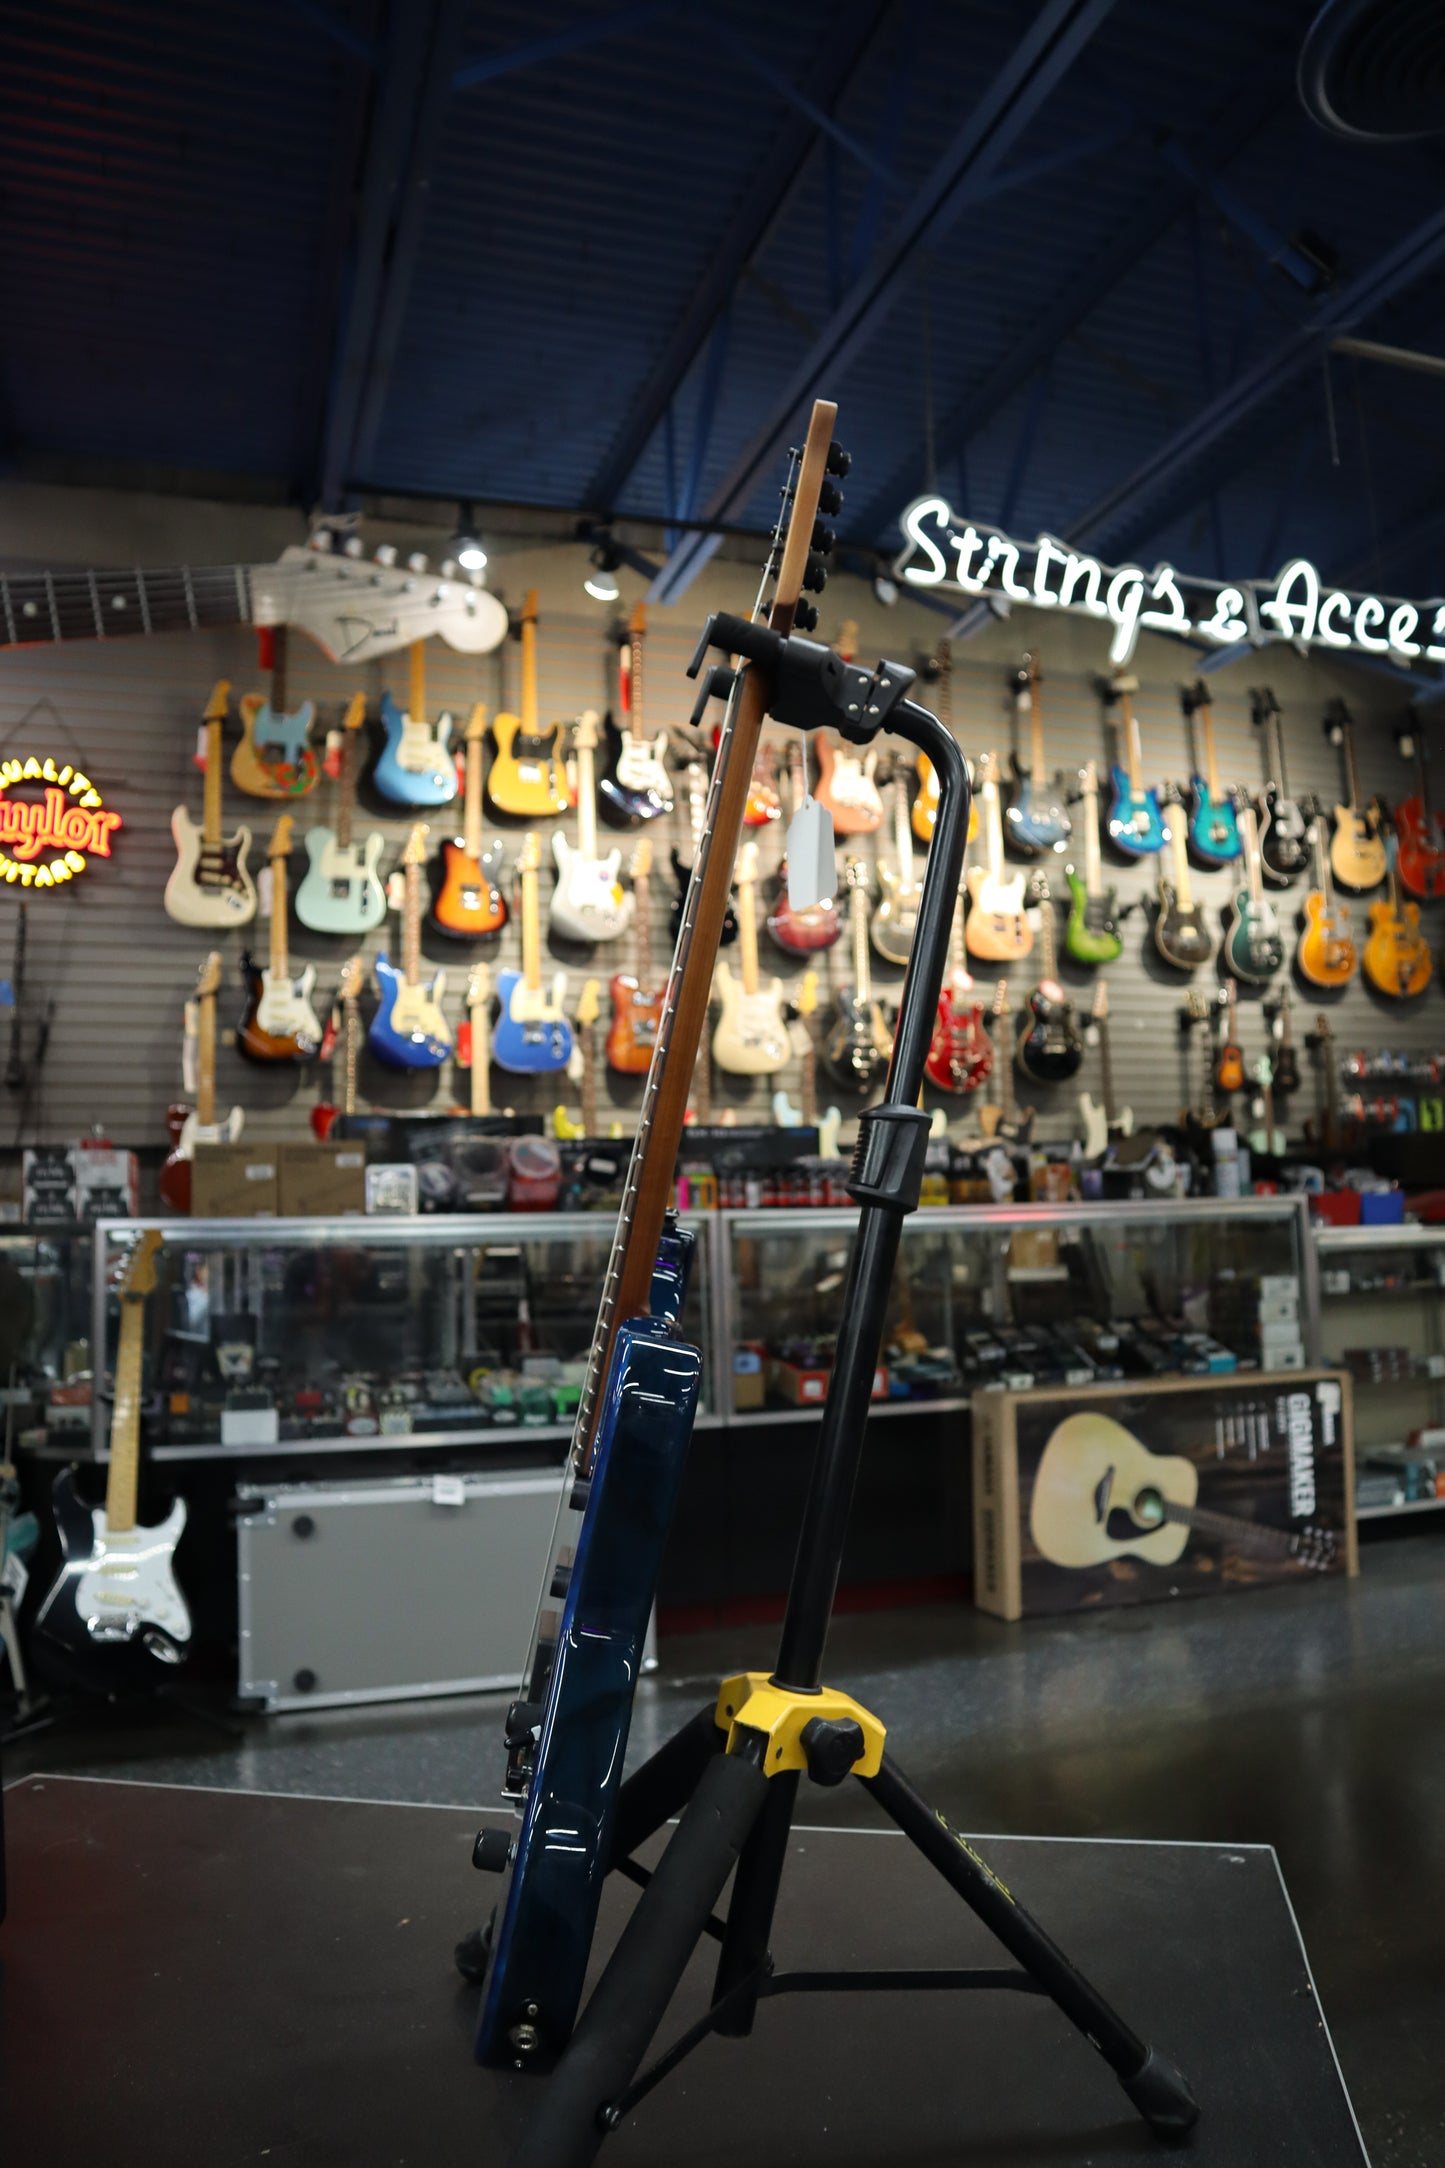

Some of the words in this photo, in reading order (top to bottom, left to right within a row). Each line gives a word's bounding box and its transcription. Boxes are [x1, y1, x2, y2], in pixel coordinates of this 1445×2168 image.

[905, 499, 1192, 665] Strings
[1197, 587, 1248, 641] &
[0, 850, 87, 888] UITARS
[1287, 1392, 1316, 1518] GIGMAKER
